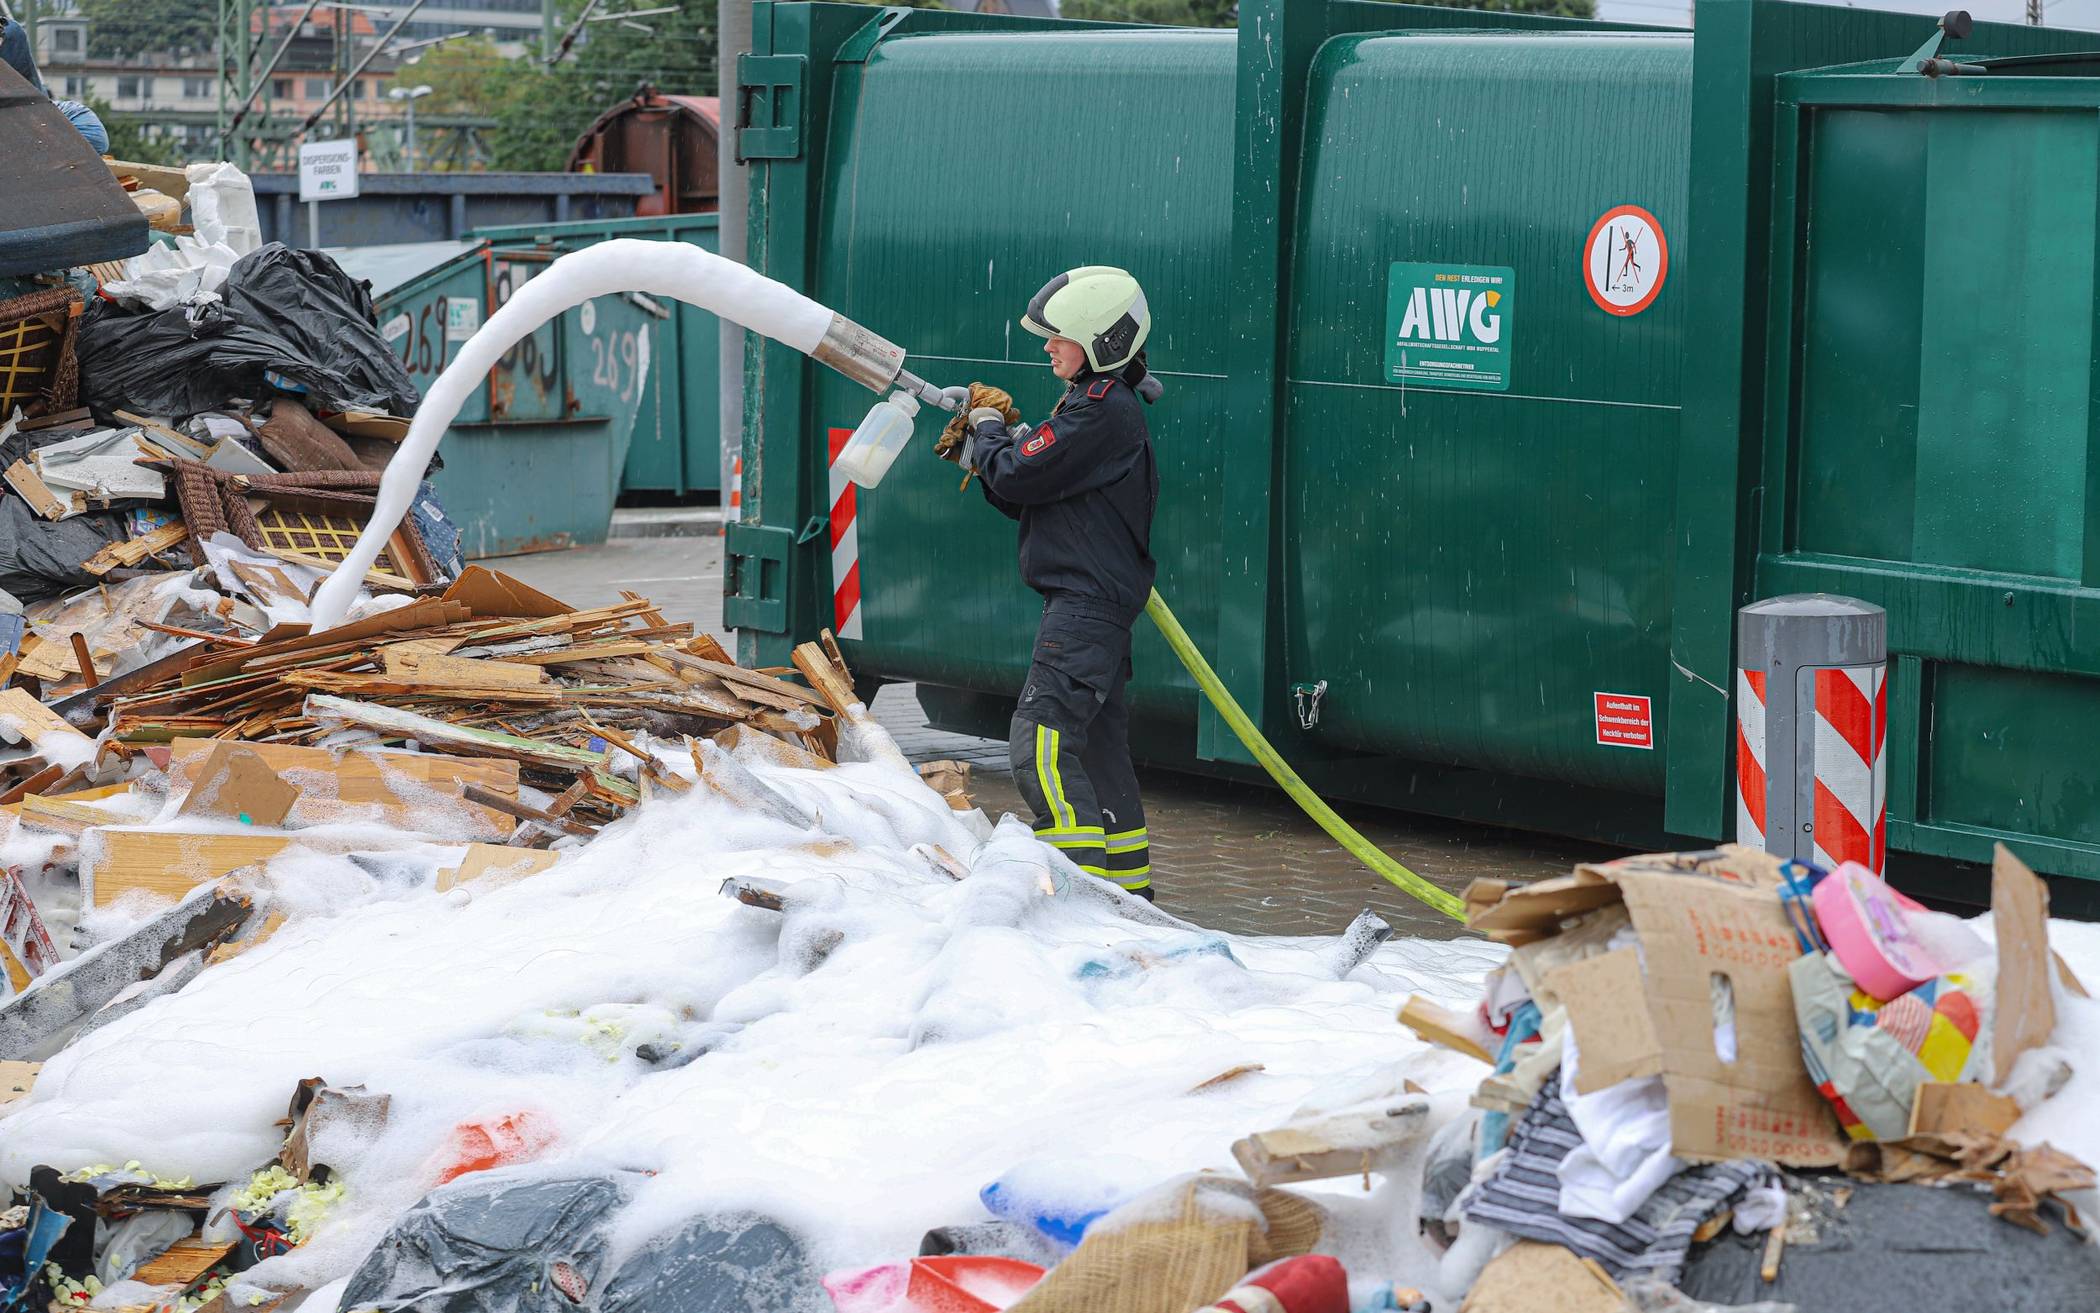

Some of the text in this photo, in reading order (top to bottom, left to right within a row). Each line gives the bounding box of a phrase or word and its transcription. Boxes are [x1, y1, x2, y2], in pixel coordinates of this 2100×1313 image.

[303, 152, 352, 165] DISPERSIONS-
[313, 165, 342, 176] FARBEN
[1461, 275, 1490, 283] ERLEDIGEN
[1622, 284, 1634, 293] 3m
[1398, 287, 1502, 344] AWG
[592, 329, 637, 402] 269
[1606, 701, 1632, 711] Aufenthalt
[1598, 715, 1649, 726] Schwenkbereich der
[1623, 731, 1647, 740] verboten!
